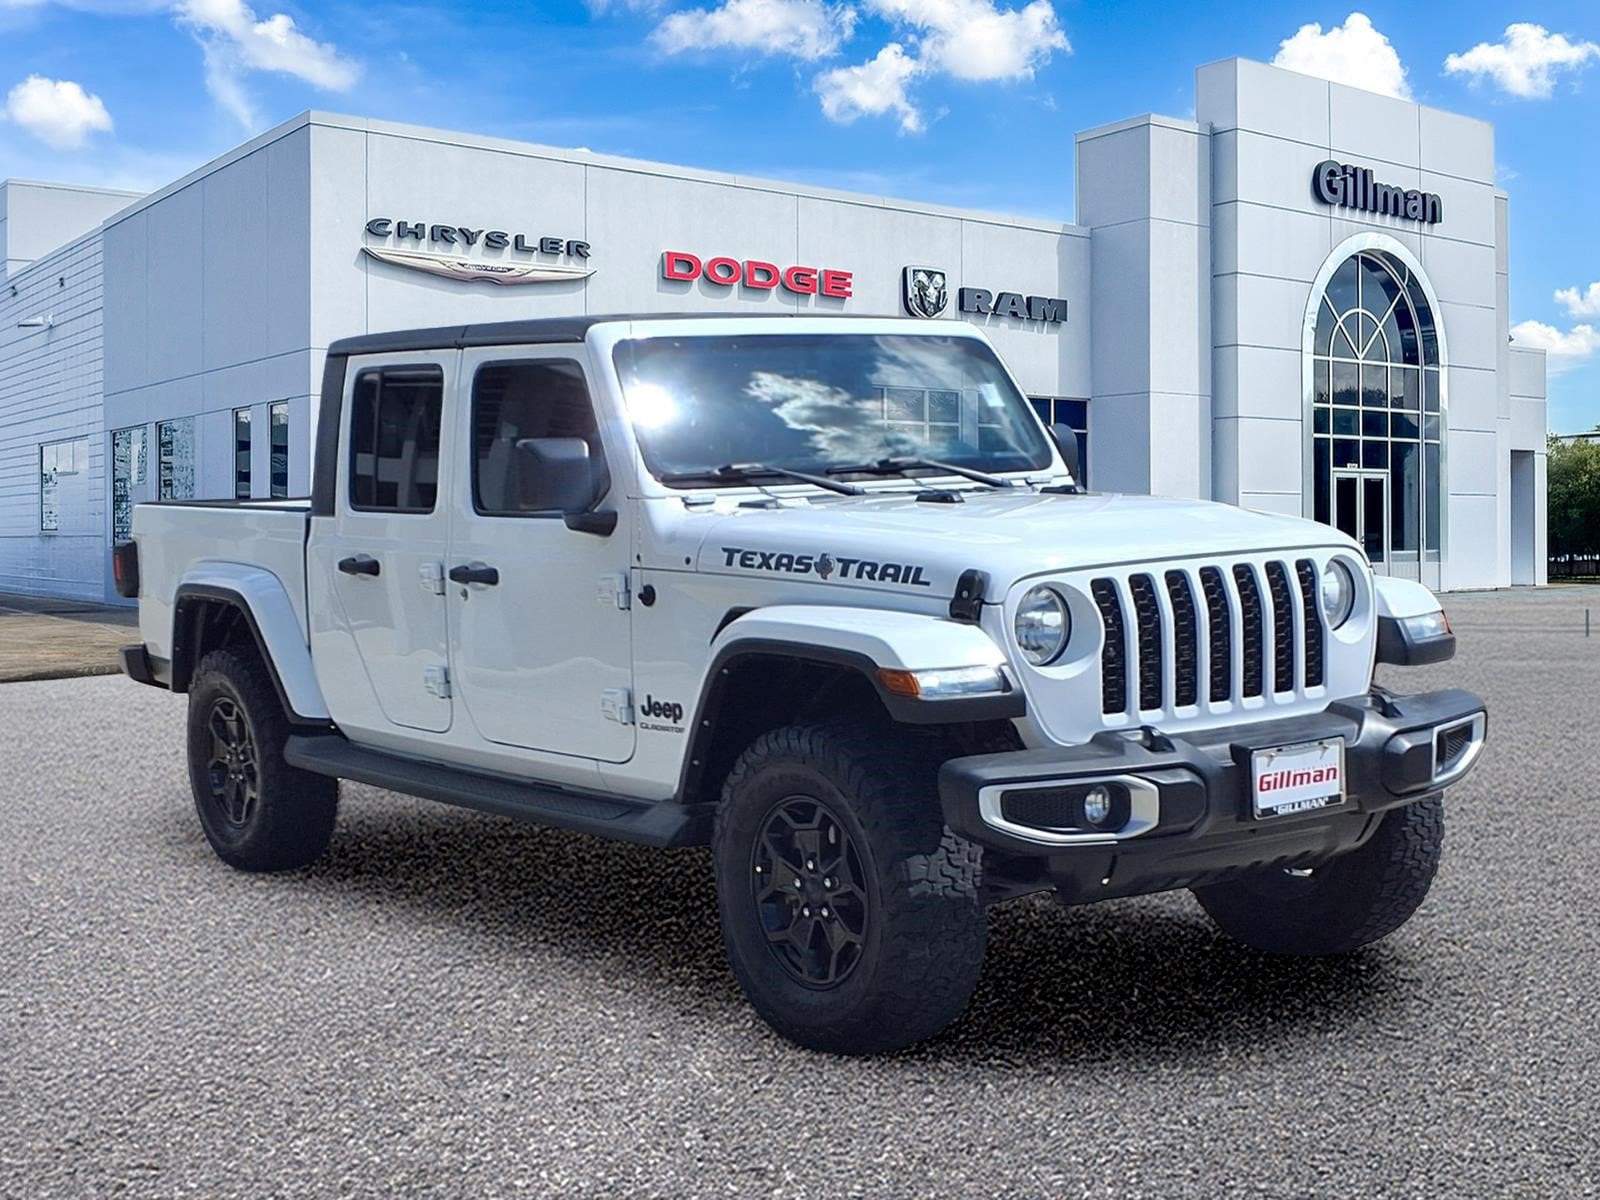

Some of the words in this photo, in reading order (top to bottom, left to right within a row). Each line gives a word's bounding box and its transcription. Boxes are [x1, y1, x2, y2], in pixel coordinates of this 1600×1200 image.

[1313, 160, 1442, 224] Gillman
[366, 217, 592, 257] CHRYSLER
[662, 251, 853, 298] DODGE
[958, 287, 1068, 324] RAM
[721, 547, 814, 573] TEXAS
[835, 557, 931, 586] TRAIL
[641, 694, 683, 724] Jeep
[1259, 767, 1337, 792] Gillman
